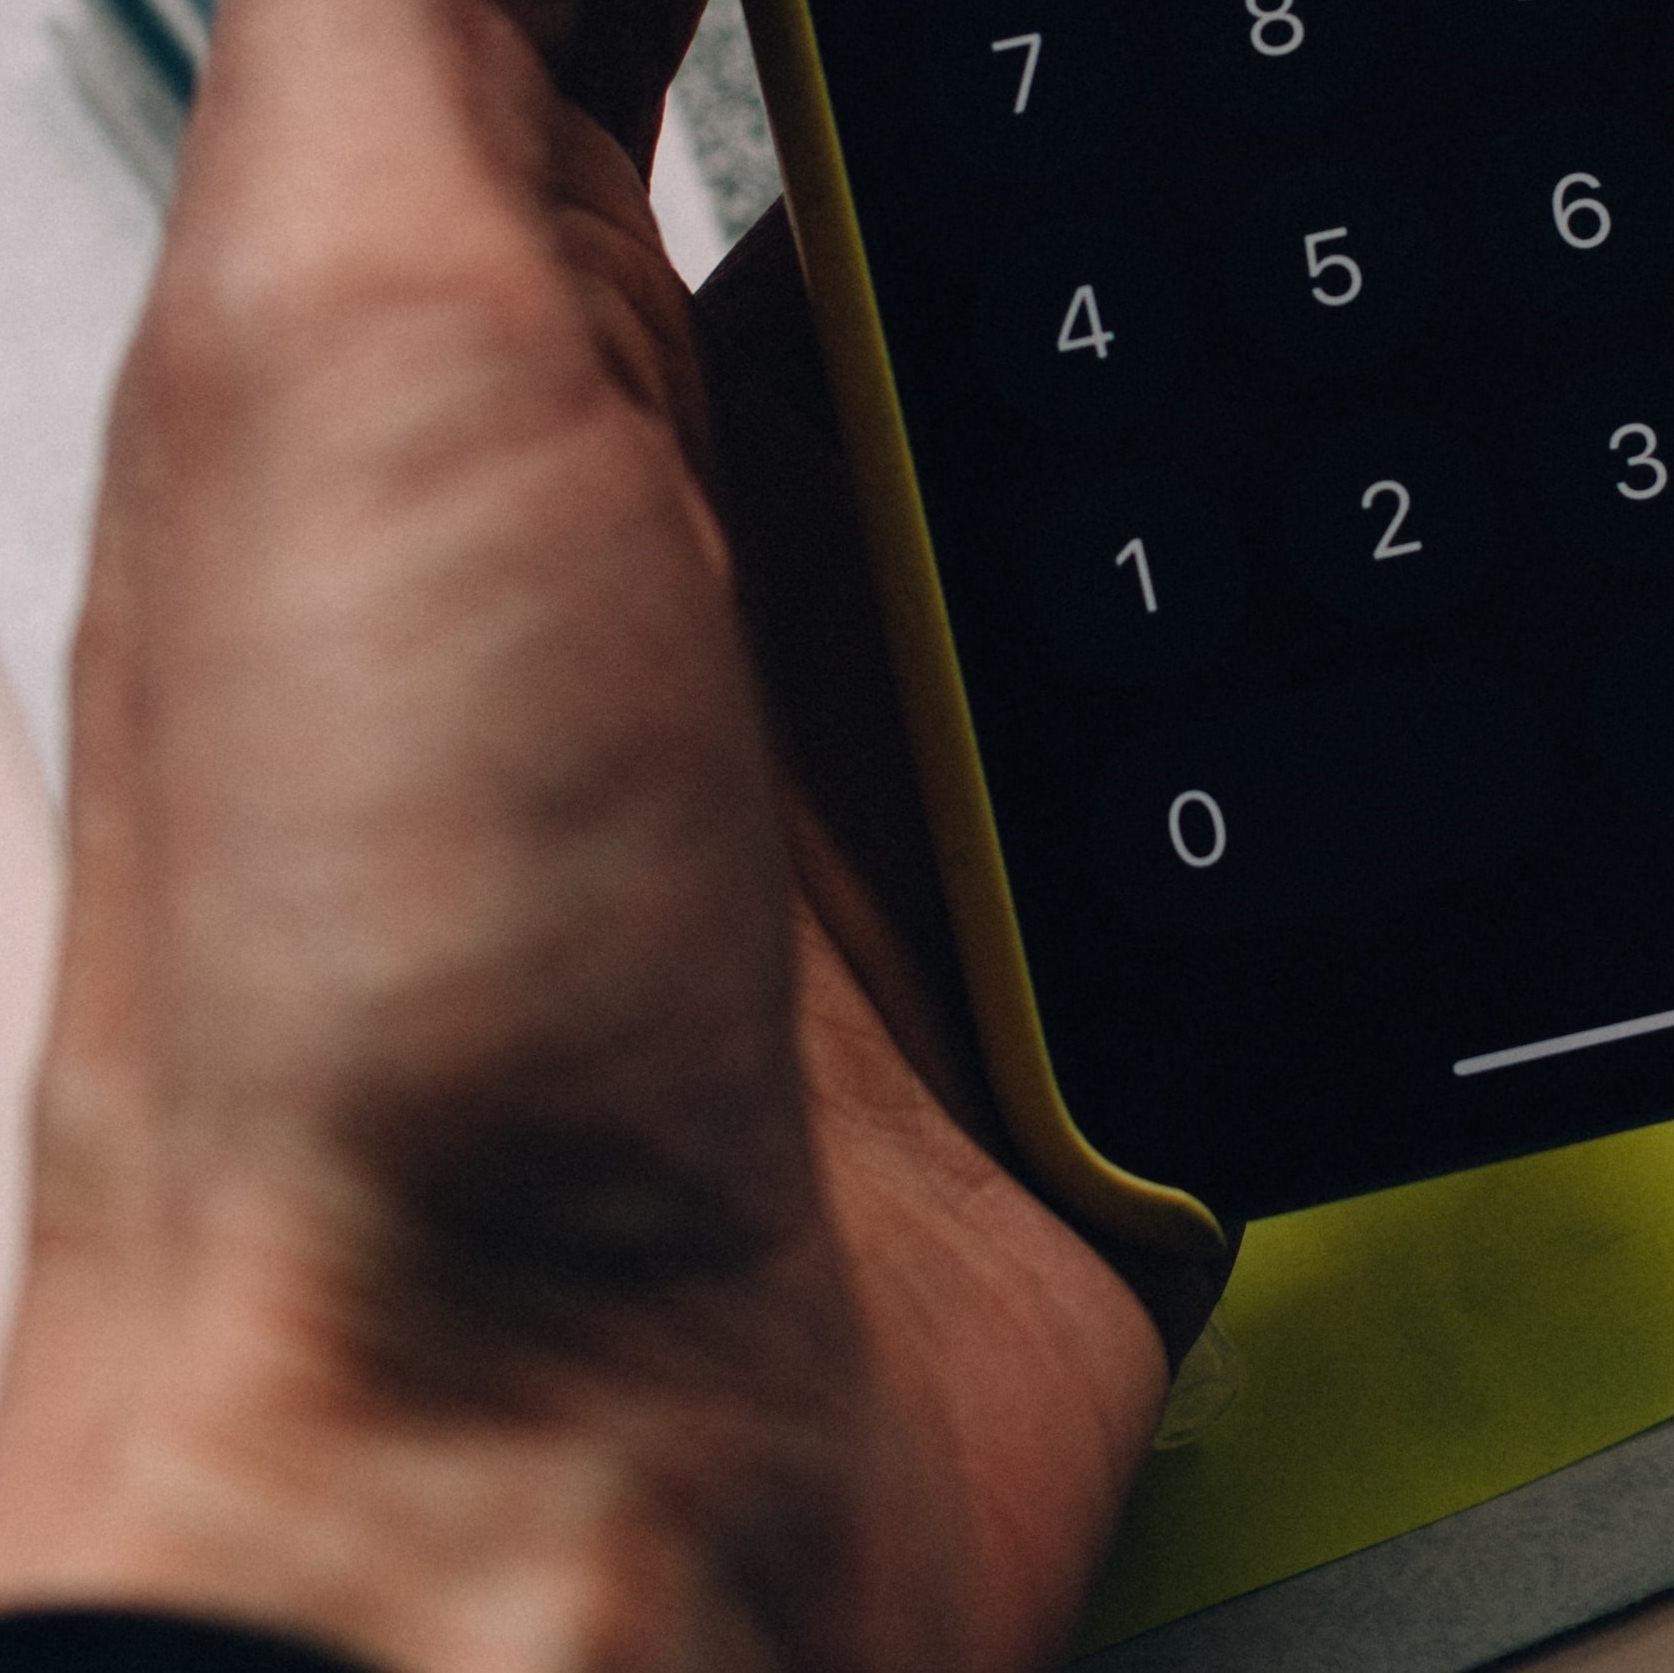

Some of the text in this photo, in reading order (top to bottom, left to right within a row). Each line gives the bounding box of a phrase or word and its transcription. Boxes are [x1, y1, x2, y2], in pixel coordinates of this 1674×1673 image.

[989, 32, 1043, 113] 7
[1057, 284, 1115, 359] 4
[1304, 227, 1362, 306] 5
[1552, 172, 1611, 249] 6
[1115, 537, 1158, 613] 1
[1361, 480, 1422, 560] 2
[1608, 422, 1669, 501] 3
[1168, 789, 1226, 867] 0
